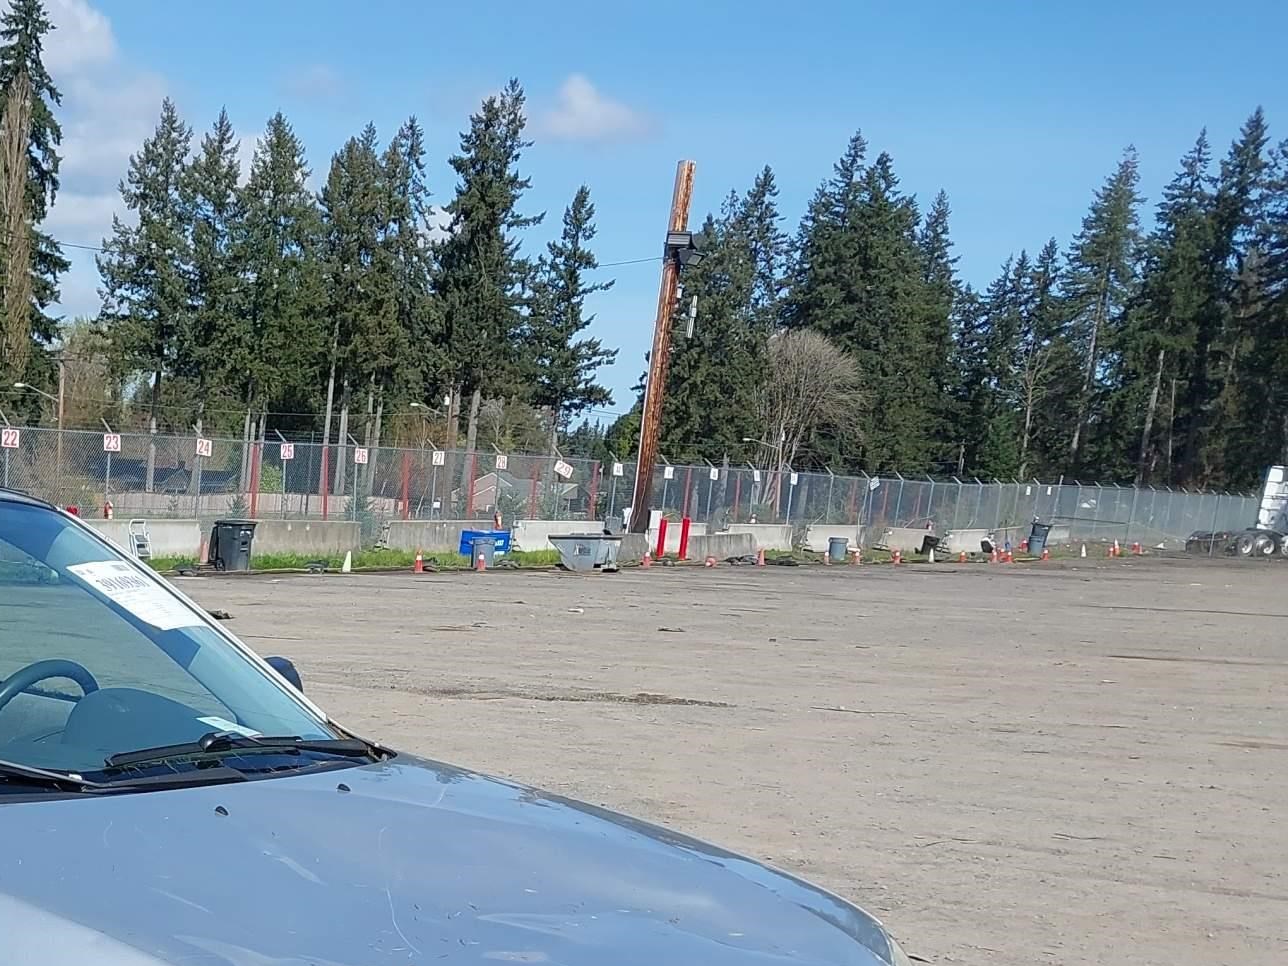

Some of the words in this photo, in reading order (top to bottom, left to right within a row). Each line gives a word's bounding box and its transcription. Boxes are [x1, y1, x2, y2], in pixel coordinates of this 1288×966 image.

[3, 431, 18, 447] 22
[105, 435, 119, 450] 23
[198, 439, 211, 455] 24
[282, 445, 293, 458] 25
[356, 449, 367, 463] 26
[434, 452, 444, 465] 27
